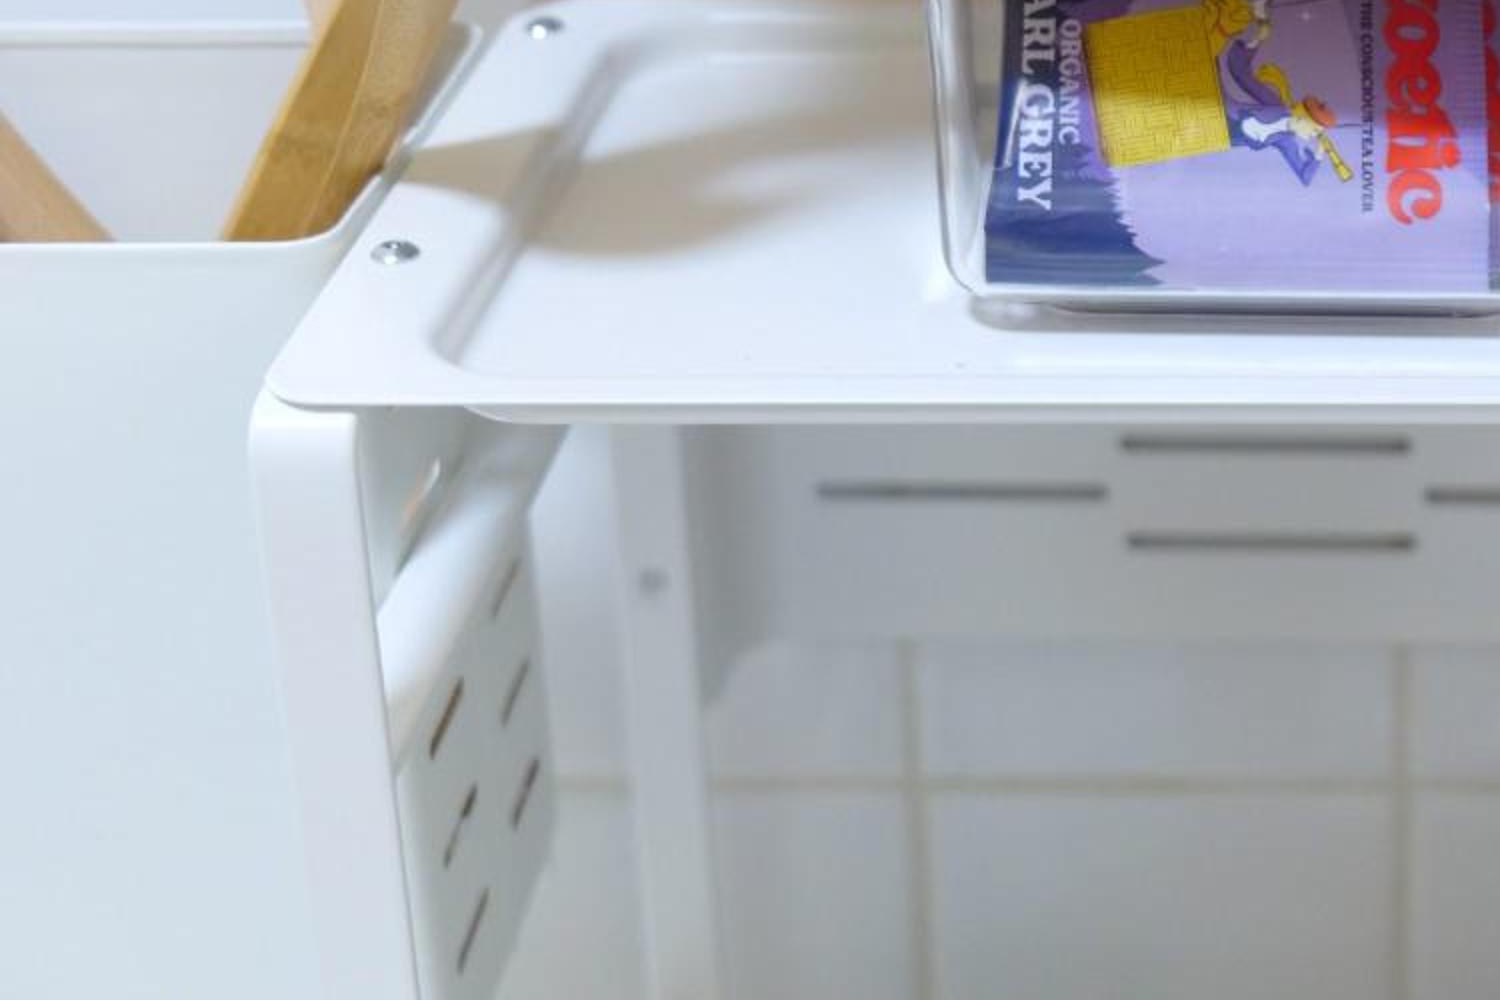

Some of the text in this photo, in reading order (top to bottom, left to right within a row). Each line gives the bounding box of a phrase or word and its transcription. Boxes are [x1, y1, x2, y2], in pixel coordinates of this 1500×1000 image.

[1359, 1, 1374, 31] THE
[1058, 18, 1081, 145] ORGANIC
[1359, 33, 1376, 124] CONSCIOUS
[1016, 83, 1056, 211] GREY
[1361, 128, 1375, 157] TEA
[1360, 161, 1375, 212] LOVER
